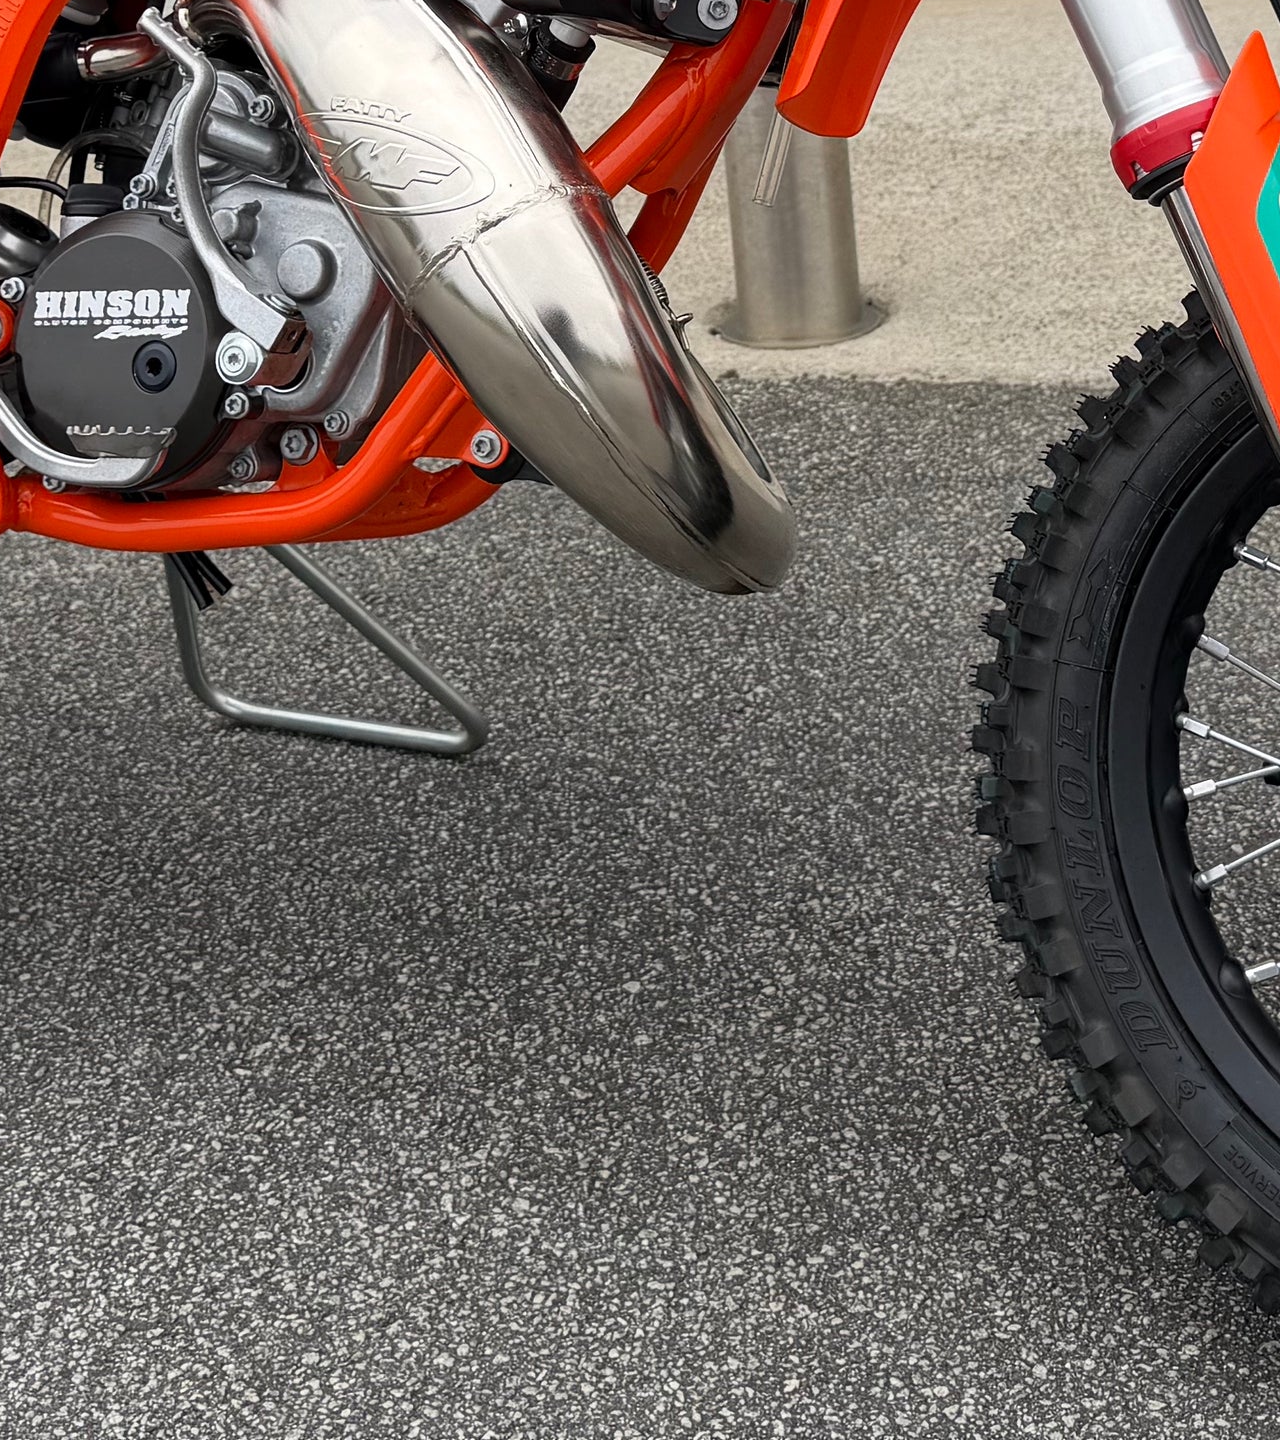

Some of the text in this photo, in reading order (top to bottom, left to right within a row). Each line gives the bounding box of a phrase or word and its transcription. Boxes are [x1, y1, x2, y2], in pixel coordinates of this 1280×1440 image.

[331, 96, 412, 122] FATTY
[34, 289, 191, 318] HINSON
[1056, 697, 1177, 1054] DUNLOP
